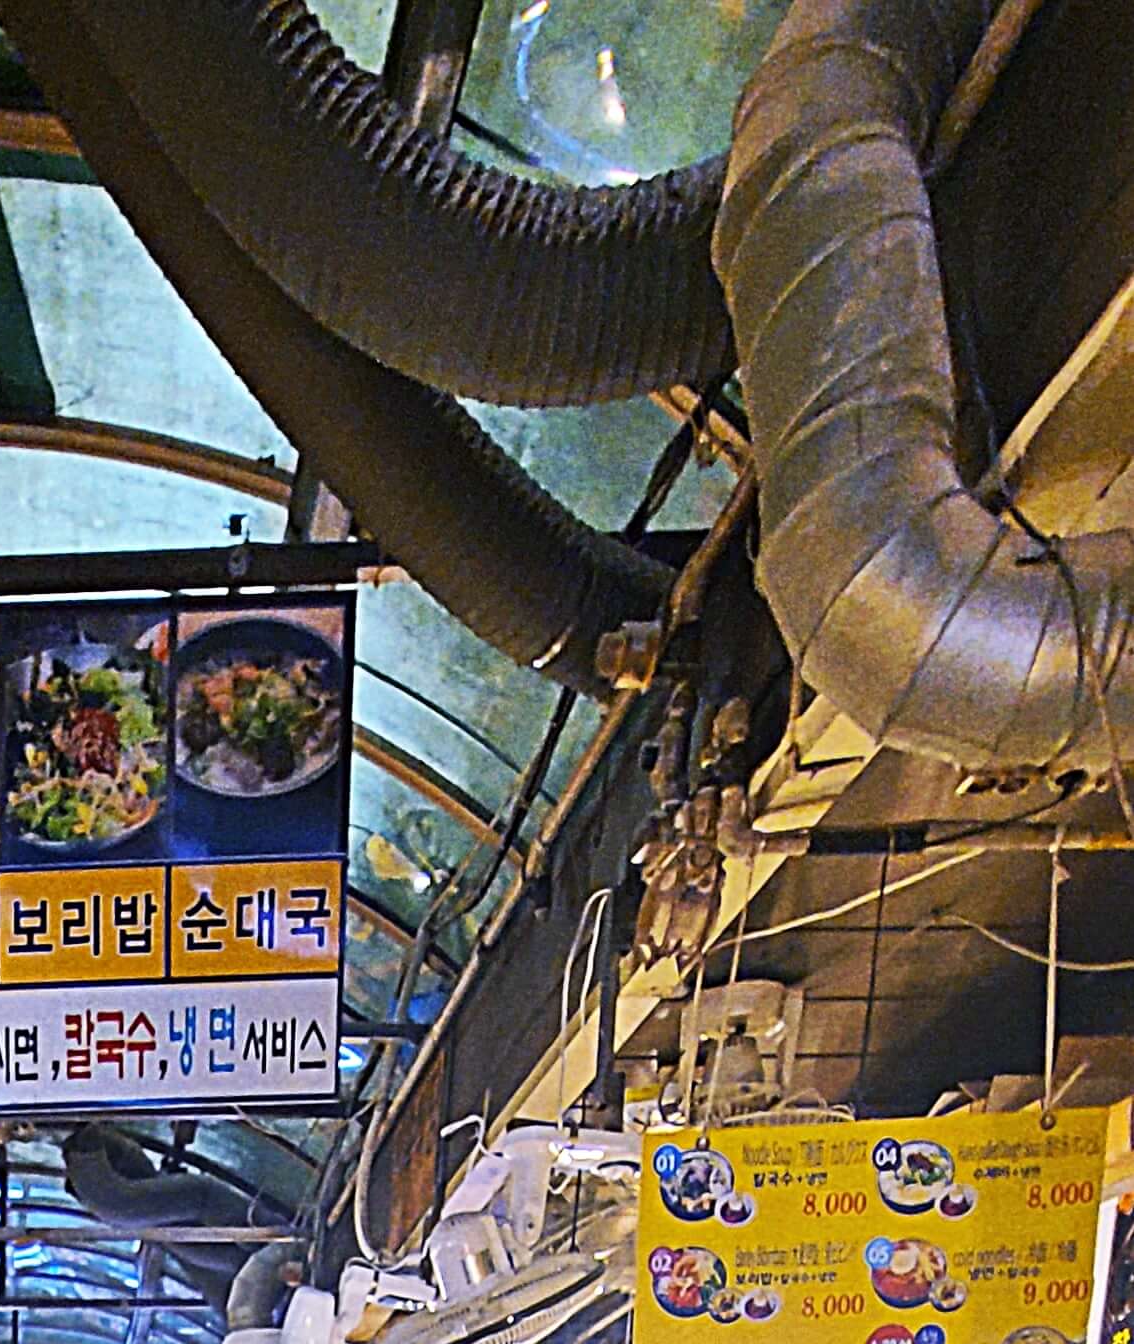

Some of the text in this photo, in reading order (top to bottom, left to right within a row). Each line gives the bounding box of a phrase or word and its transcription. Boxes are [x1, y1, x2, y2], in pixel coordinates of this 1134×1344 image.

[6, 894, 159, 957] 보리밥
[180, 886, 332, 953] 순대국
[655, 1154, 676, 1173] 01
[874, 1147, 899, 1166] 04
[869, 1245, 892, 1264] 05
[650, 1256, 673, 1273] 02
